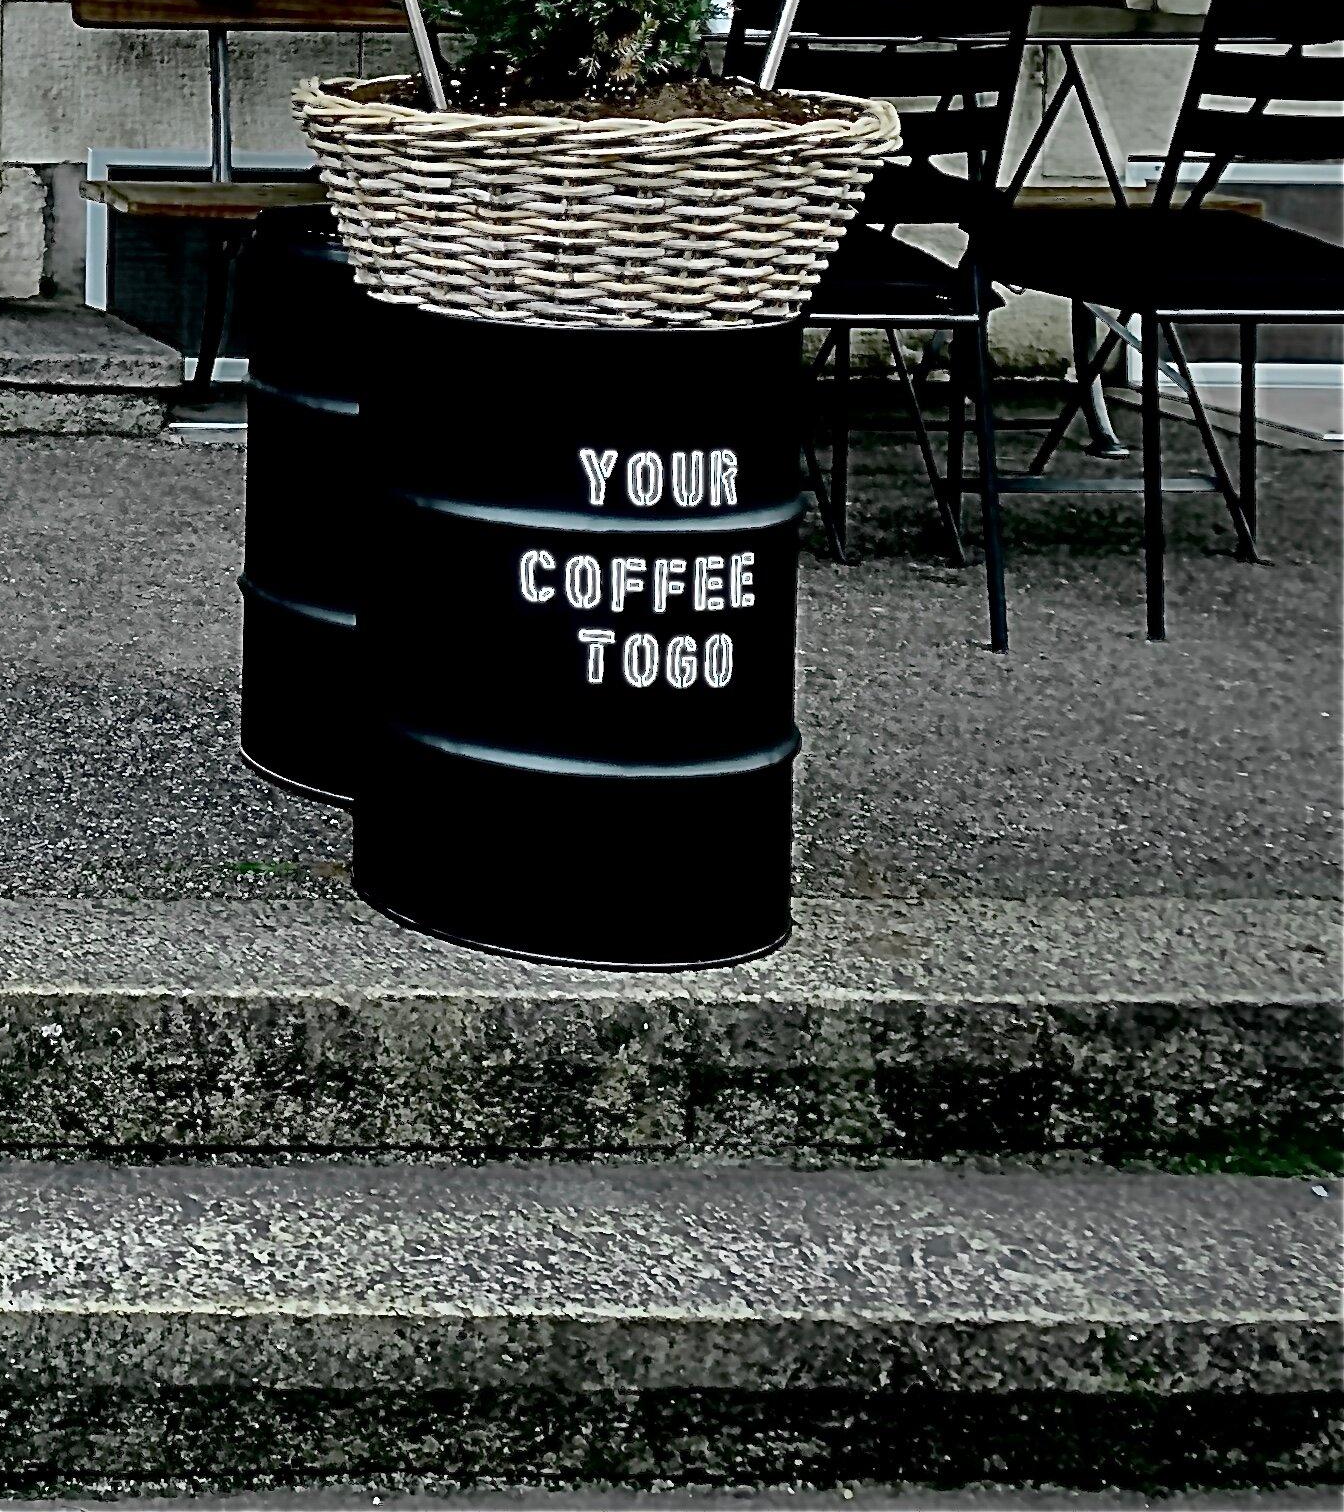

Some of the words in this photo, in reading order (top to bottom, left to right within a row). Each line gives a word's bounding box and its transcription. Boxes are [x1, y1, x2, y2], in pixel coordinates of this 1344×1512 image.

[578, 448, 739, 506] YOUR
[518, 549, 756, 613] COFFEE
[578, 629, 734, 688] TOGO
